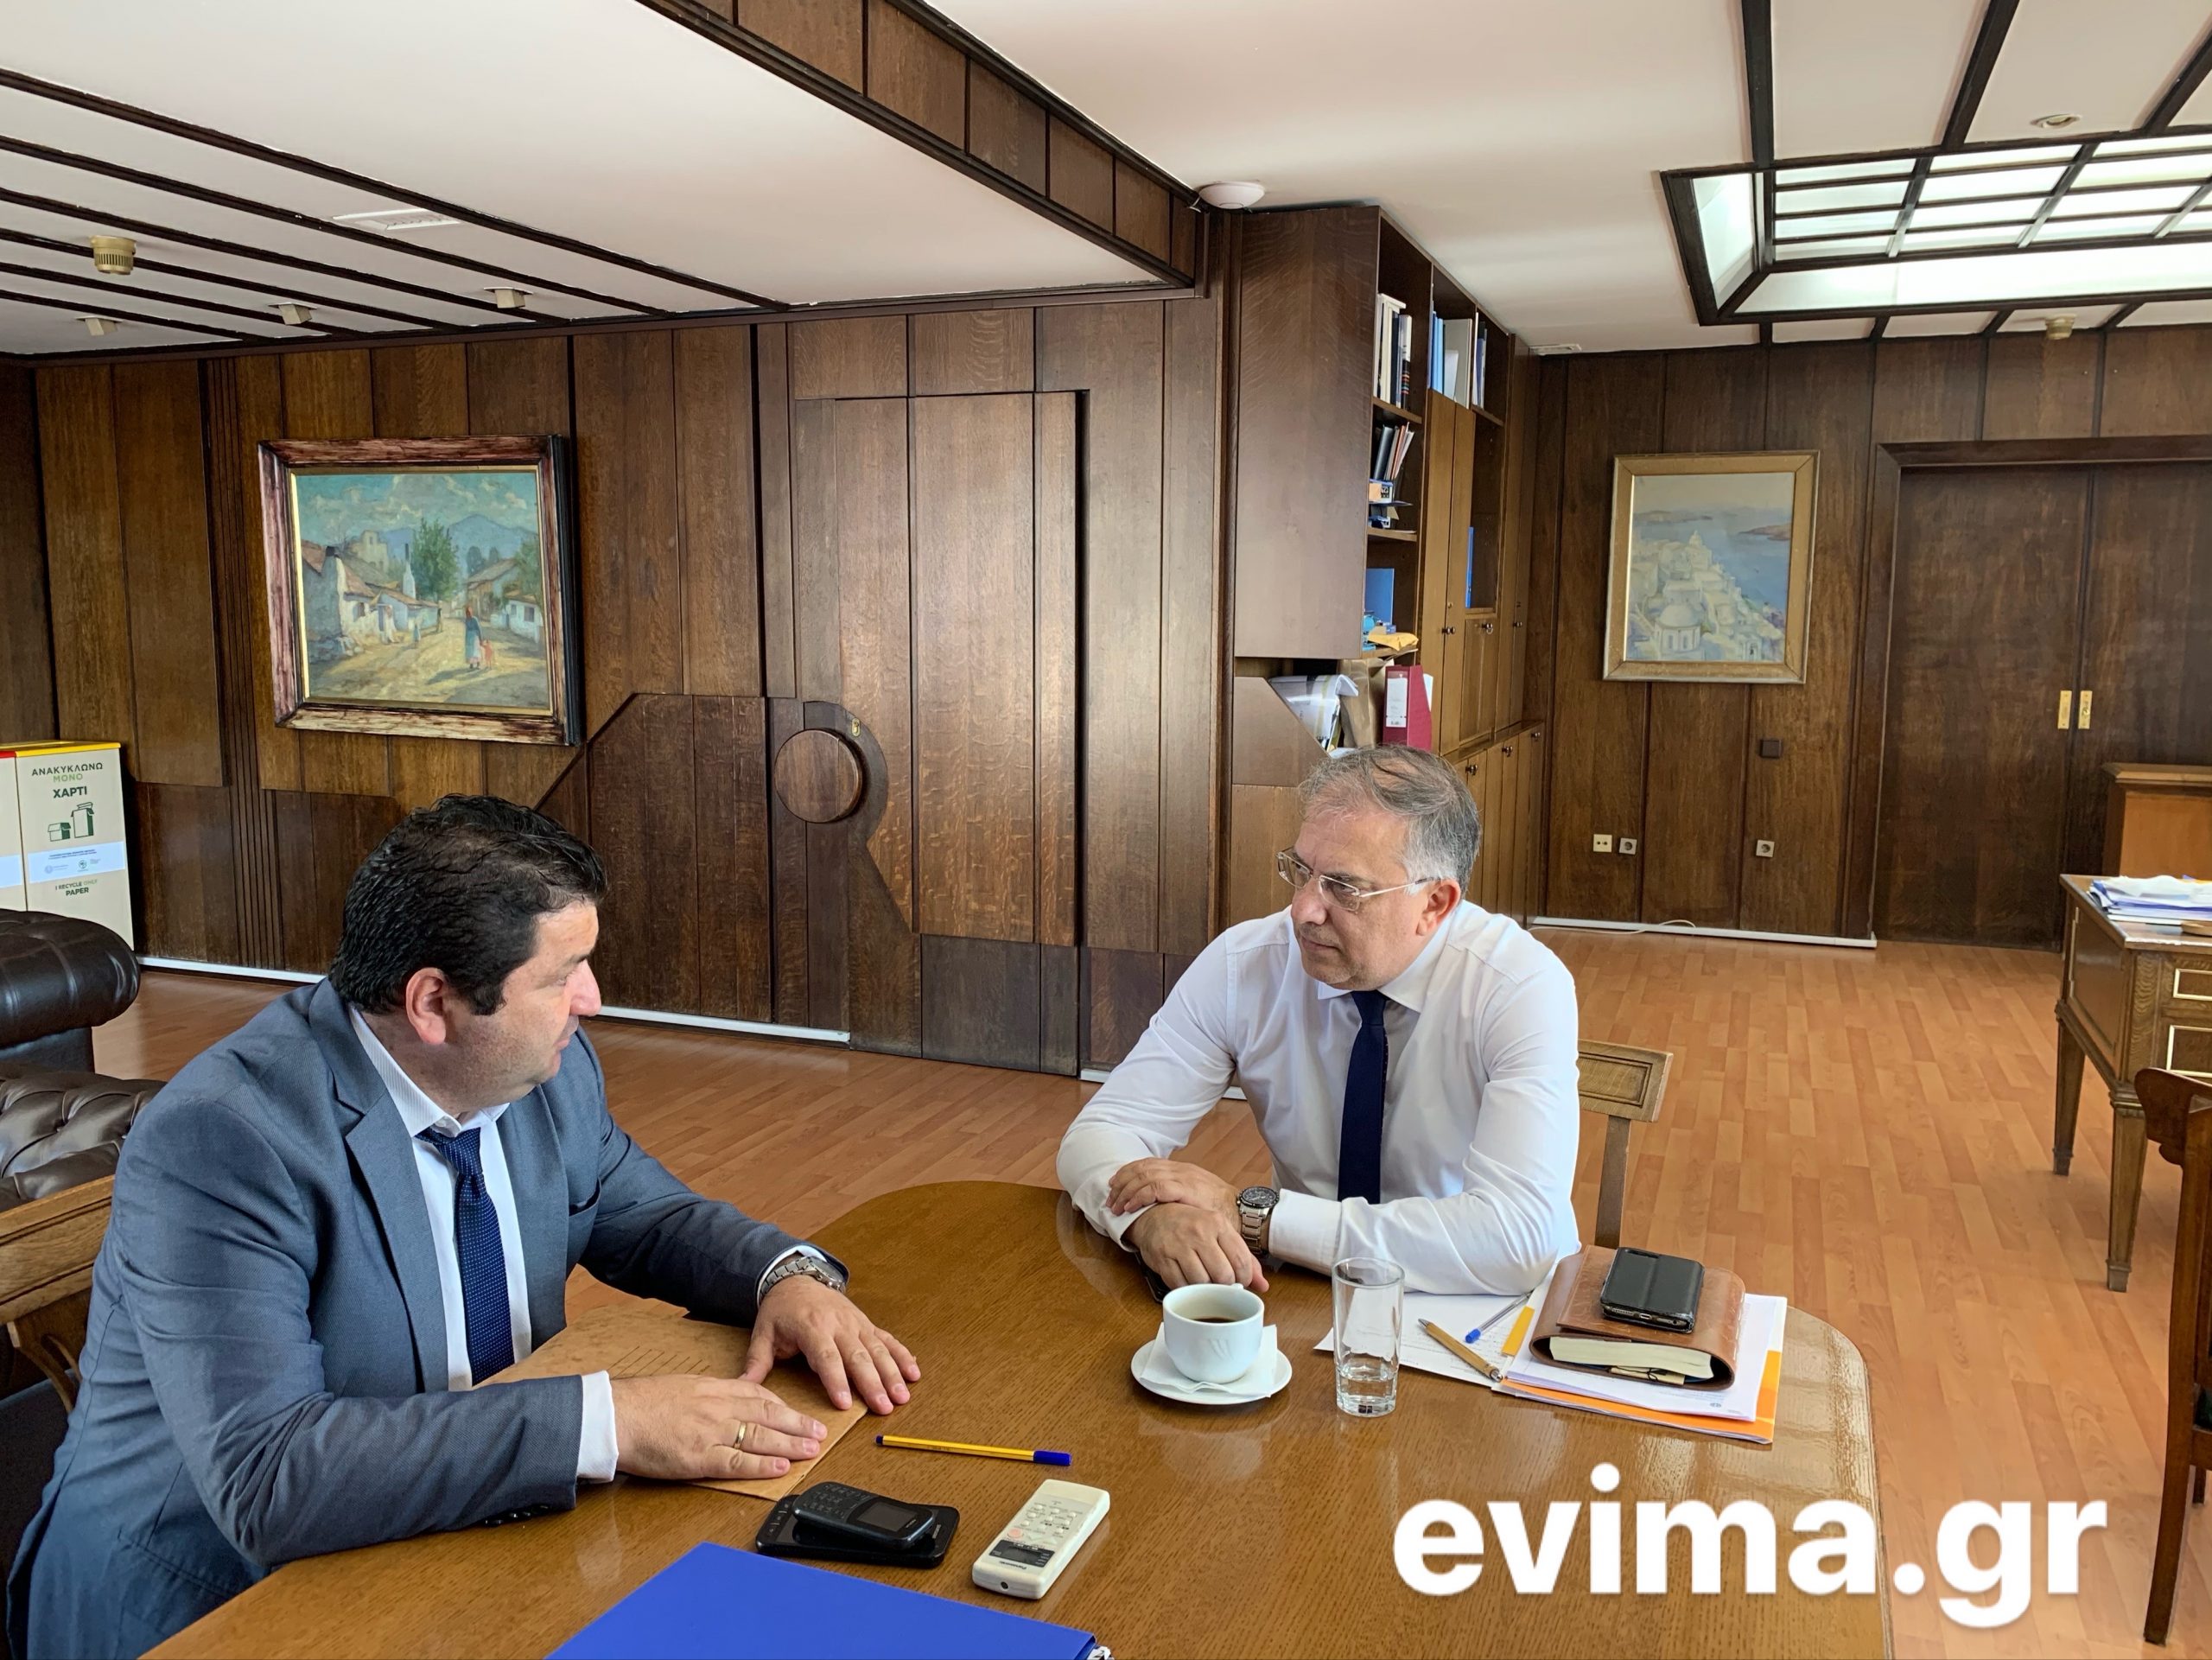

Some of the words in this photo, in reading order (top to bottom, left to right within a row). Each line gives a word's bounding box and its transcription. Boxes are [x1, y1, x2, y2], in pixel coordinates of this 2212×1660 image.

[31, 762, 103, 776] ΑΝΑΚΥΚΛΩΝΩ
[53, 773, 83, 783] ΜΟΝΟ
[53, 785, 87, 798] ΧΑΡΤΙ
[59, 881, 83, 889] RECYCLE
[66, 887, 89, 896] PAPER
